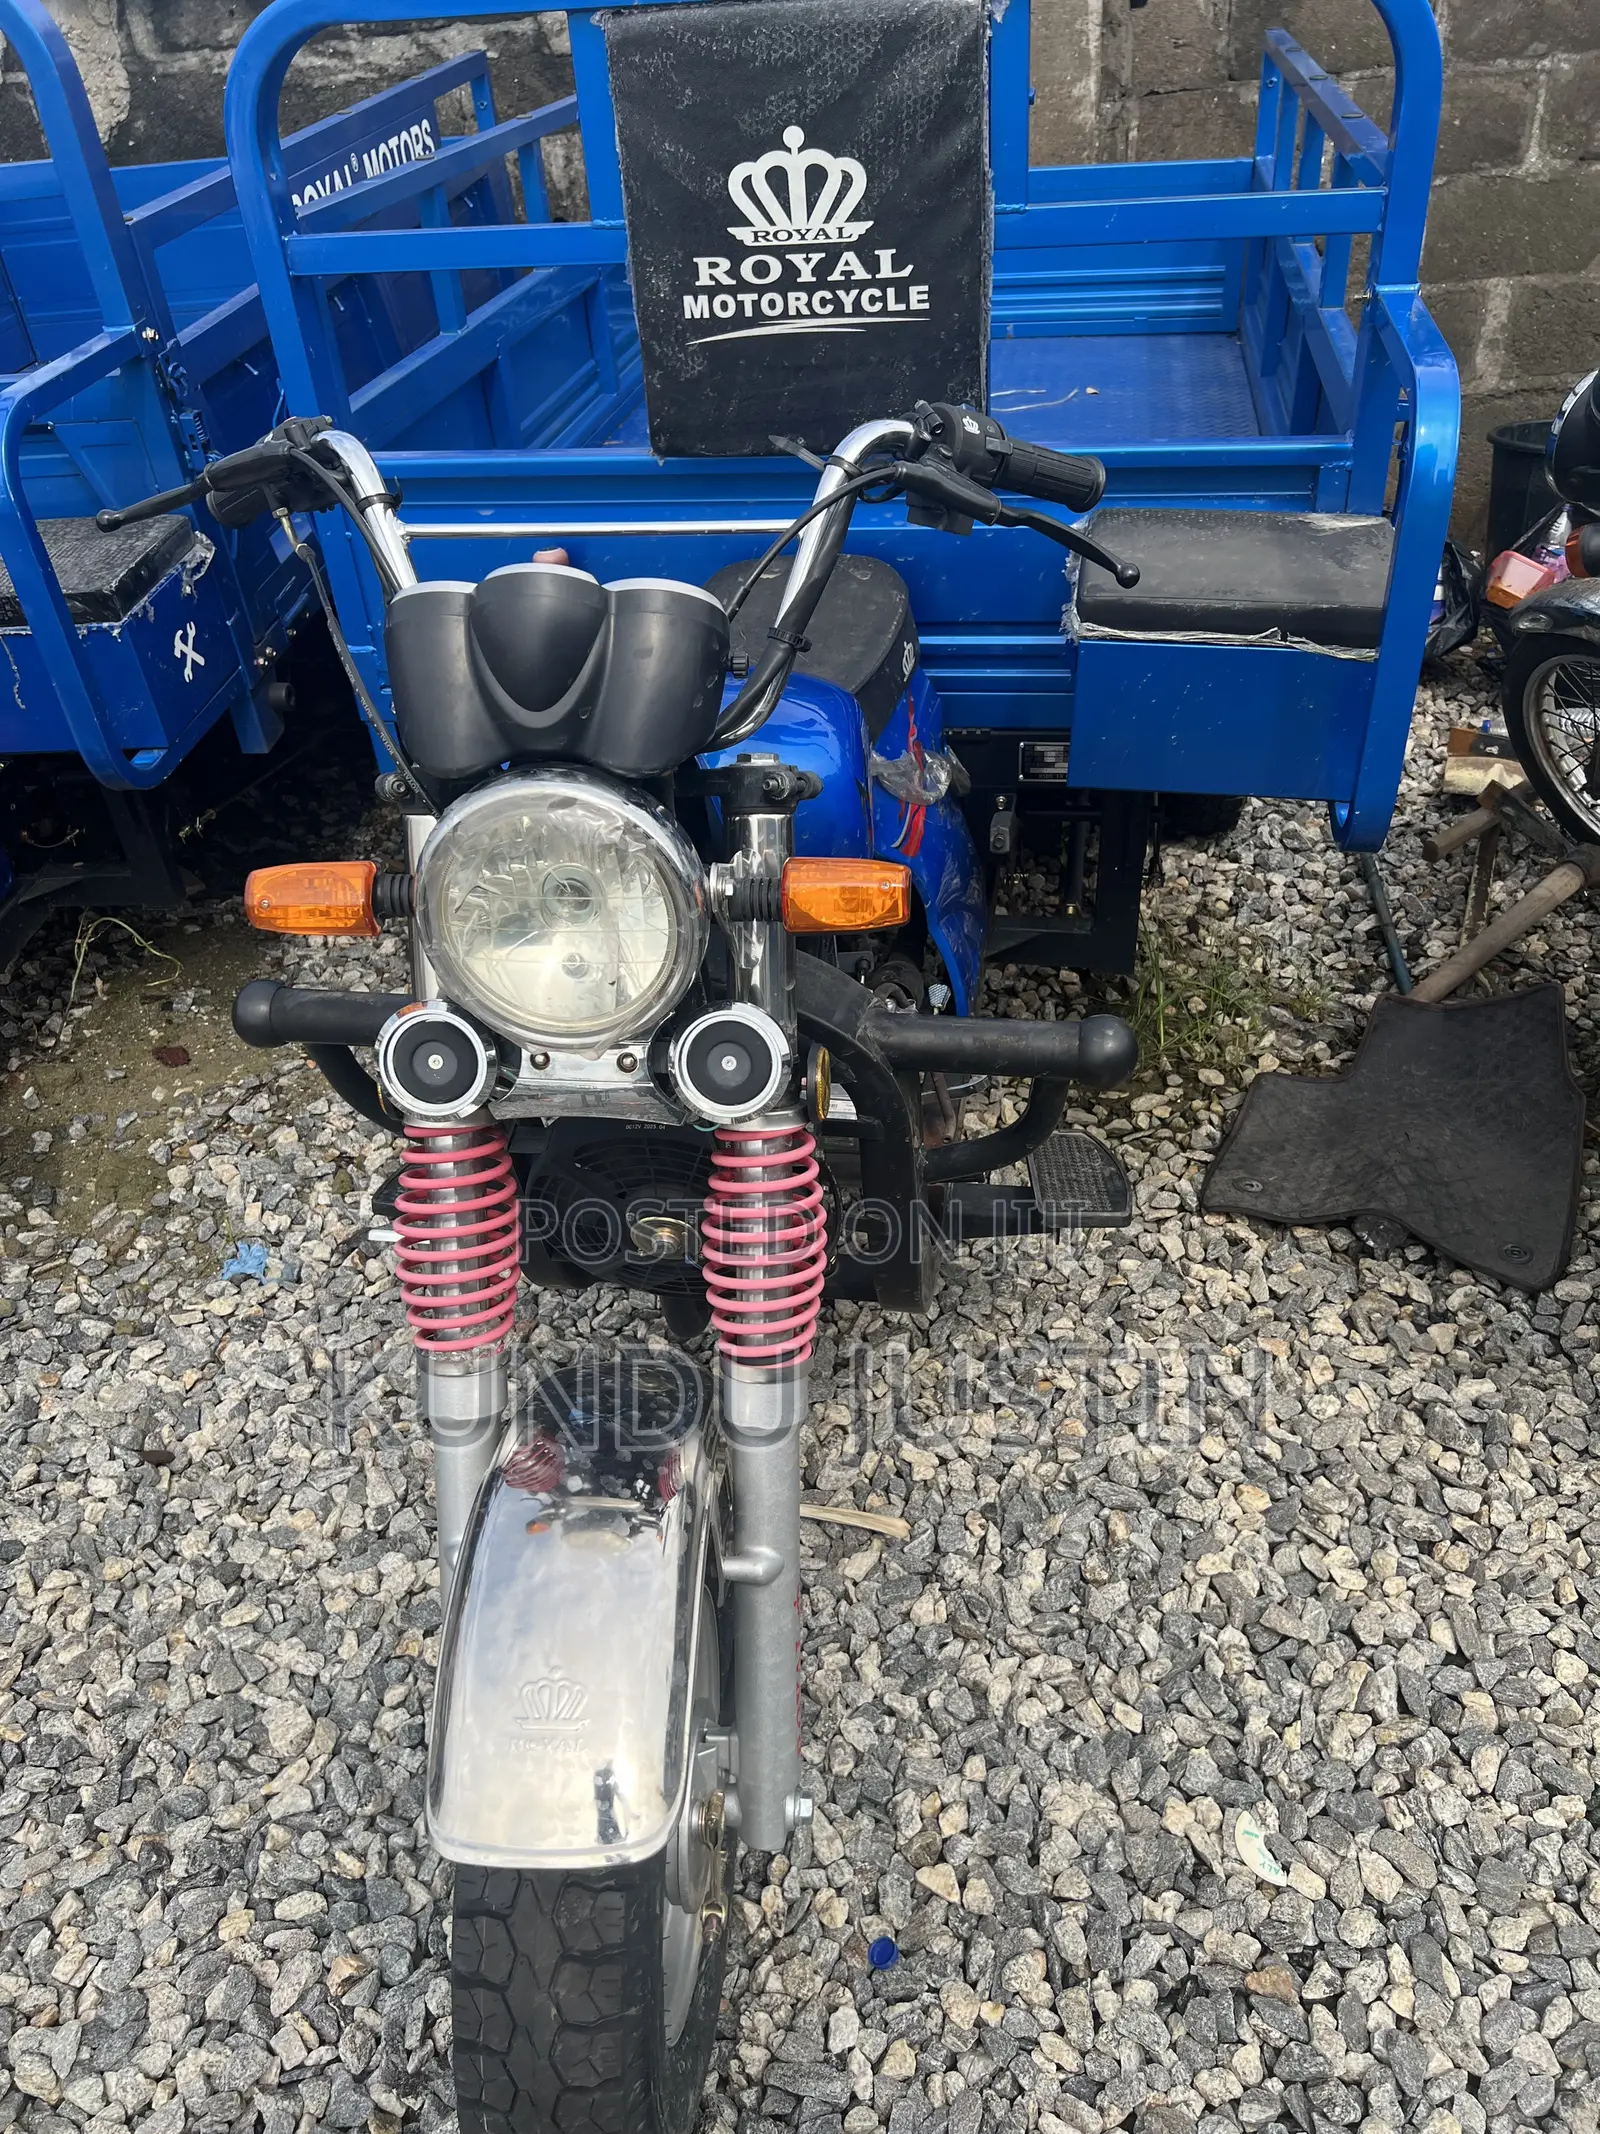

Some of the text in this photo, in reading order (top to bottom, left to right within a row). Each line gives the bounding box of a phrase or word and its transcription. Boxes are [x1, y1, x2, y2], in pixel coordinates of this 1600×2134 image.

[750, 226, 854, 243] ROYAL
[692, 248, 915, 287] ROYAL
[682, 285, 931, 320] MOTORCYCLE
[403, 769, 420, 794] ROYAL
